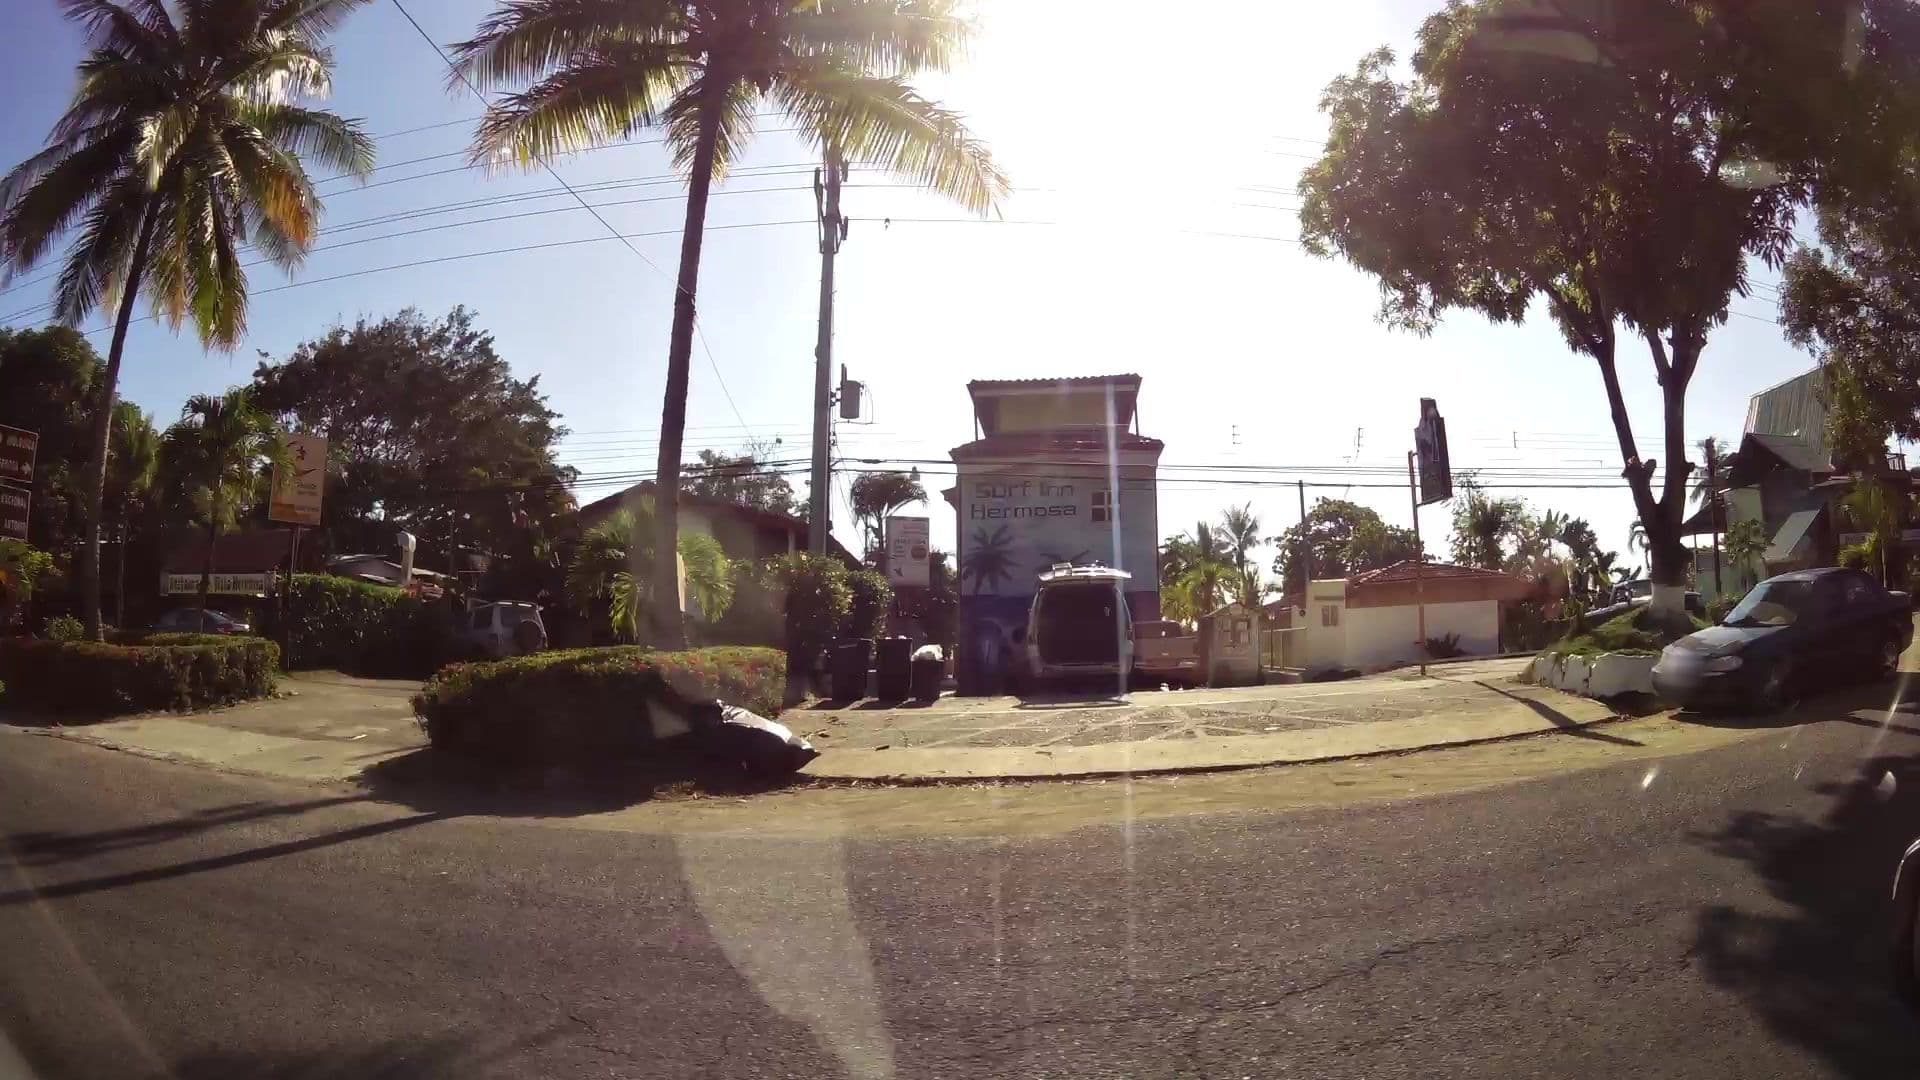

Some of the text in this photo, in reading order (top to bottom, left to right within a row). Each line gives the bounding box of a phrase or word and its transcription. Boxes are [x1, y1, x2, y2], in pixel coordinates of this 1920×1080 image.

[976, 480, 1074, 498] Surf Inn
[971, 503, 1077, 520] Hermosa
